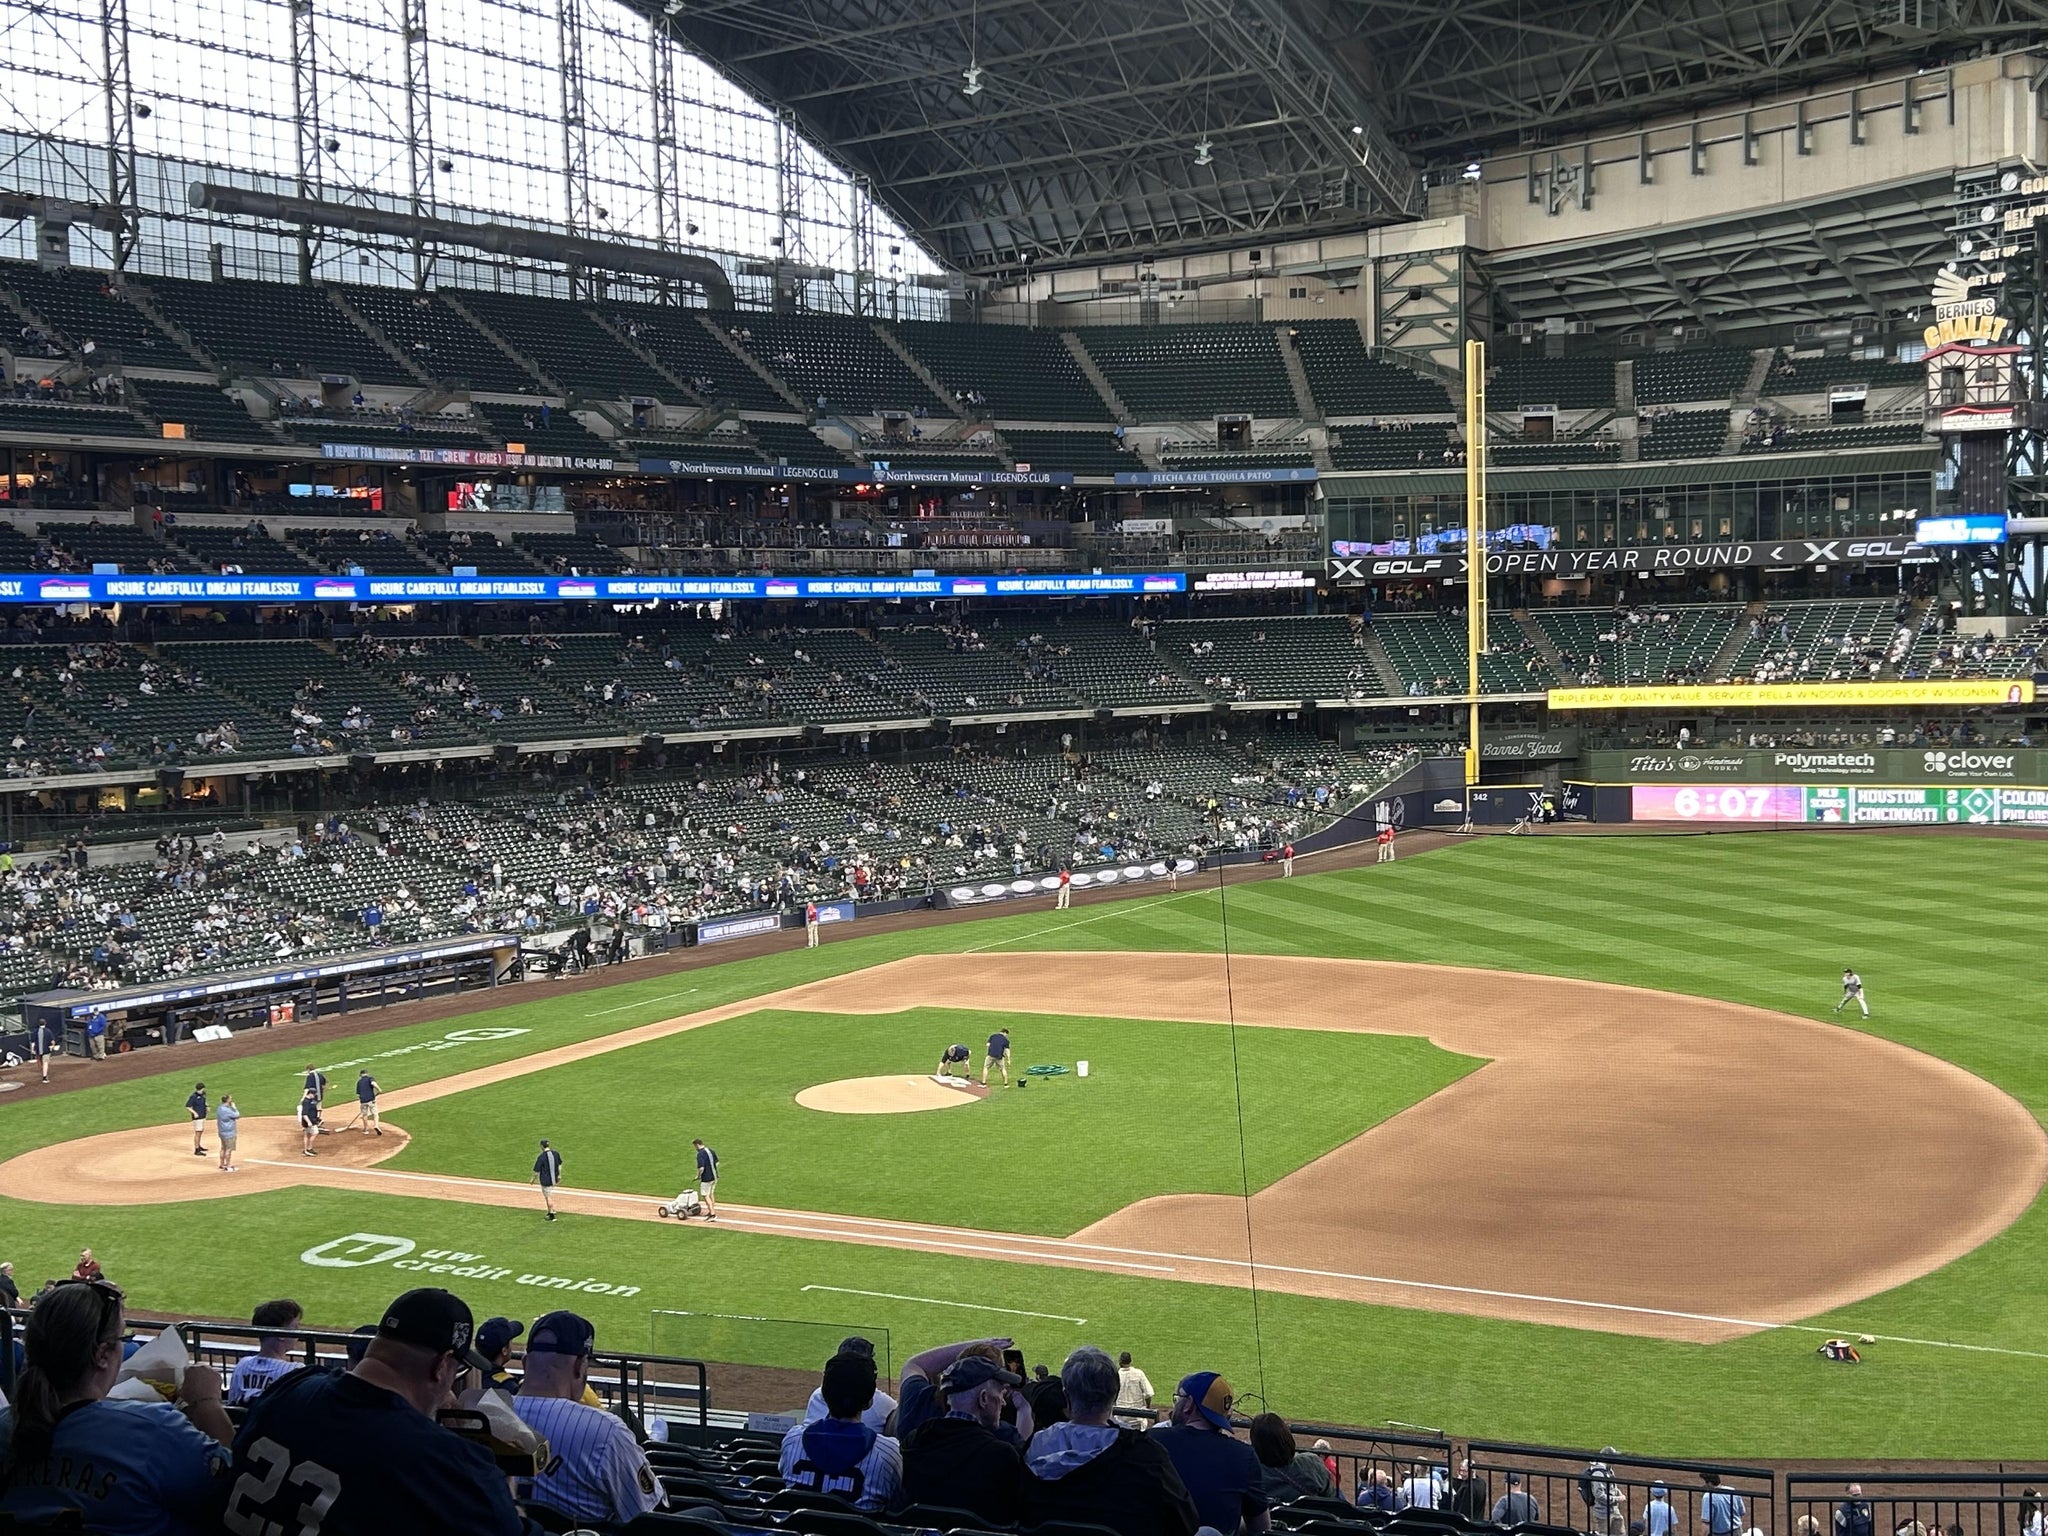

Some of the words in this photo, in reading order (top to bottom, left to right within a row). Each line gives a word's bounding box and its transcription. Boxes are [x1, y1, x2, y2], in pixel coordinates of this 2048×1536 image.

[2004, 208, 2026, 222] GET
[1979, 249, 1999, 261] GET
[2003, 245, 2020, 258] UP
[1968, 274, 1988, 287] GET
[1990, 272, 2007, 285] UP
[1937, 300, 1995, 320] BERNIE'S
[1923, 315, 2008, 349] CHALET
[419, 450, 435, 461] TEXT
[525, 456, 536, 466] AND
[681, 462, 742, 475] Northwestern
[744, 466, 775, 476] Mutual
[783, 468, 818, 478] LEGENDS
[819, 469, 839, 479] CLUB
[886, 472, 948, 482] Northwestern
[950, 472, 982, 482] Mutual
[991, 472, 1028, 483] LEGENDS
[1029, 473, 1050, 483] CLUB
[1153, 474, 1184, 483] FLECHA
[1187, 473, 1208, 482] AZUL
[1210, 472, 1245, 481] TEQUILA
[1247, 472, 1272, 480] PATIO
[1372, 559, 1442, 575] GOLF
[1486, 553, 1559, 573] OPEN
[1571, 550, 1639, 570] YEAR
[1654, 546, 1753, 567] ROUND
[1847, 542, 1924, 557] GOLF
[107, 582, 144, 596] INSURE
[146, 582, 205, 597] CAREFULLY,
[207, 582, 241, 596] DREAM
[243, 582, 301, 596] FEARLESSLY.
[370, 583, 405, 595] INSURE
[406, 583, 459, 596] CAREFULLY,
[460, 583, 492, 595] DREAM
[493, 583, 547, 595] FEARLESSLY.
[684, 583, 710, 594] DREAM
[711, 583, 756, 594] FEARLESSLY.
[1552, 694, 1586, 704] TRIPLE
[1589, 693, 1613, 703] PLAY
[1620, 692, 1665, 703] QUALITY
[1669, 691, 1702, 701] VALUE
[1708, 690, 1753, 700] SERVICE
[1759, 690, 1793, 699] PELLA
[1869, 690, 1909, 699] DOORS
[1911, 689, 1928, 698] OF
[1932, 688, 2000, 698] WSCONSIN
[1481, 743, 1525, 756] Barrel
[1527, 741, 1562, 758] Yard
[1630, 756, 1676, 772] Tito's
[1774, 753, 1875, 768] Polymatech
[1948, 751, 2014, 768] clover
[1473, 793, 1488, 801] 342
[1674, 788, 1770, 818] 6:07
[1857, 789, 1926, 804] HOUSTON
[1946, 789, 1958, 804] 2
[1857, 807, 1938, 821] CINCINNATI
[1946, 807, 1958, 821] 0
[420, 1249, 485, 1263] uw
[392, 1259, 512, 1280] credit
[515, 1272, 642, 1297] union
[224, 1436, 341, 1536] 23
